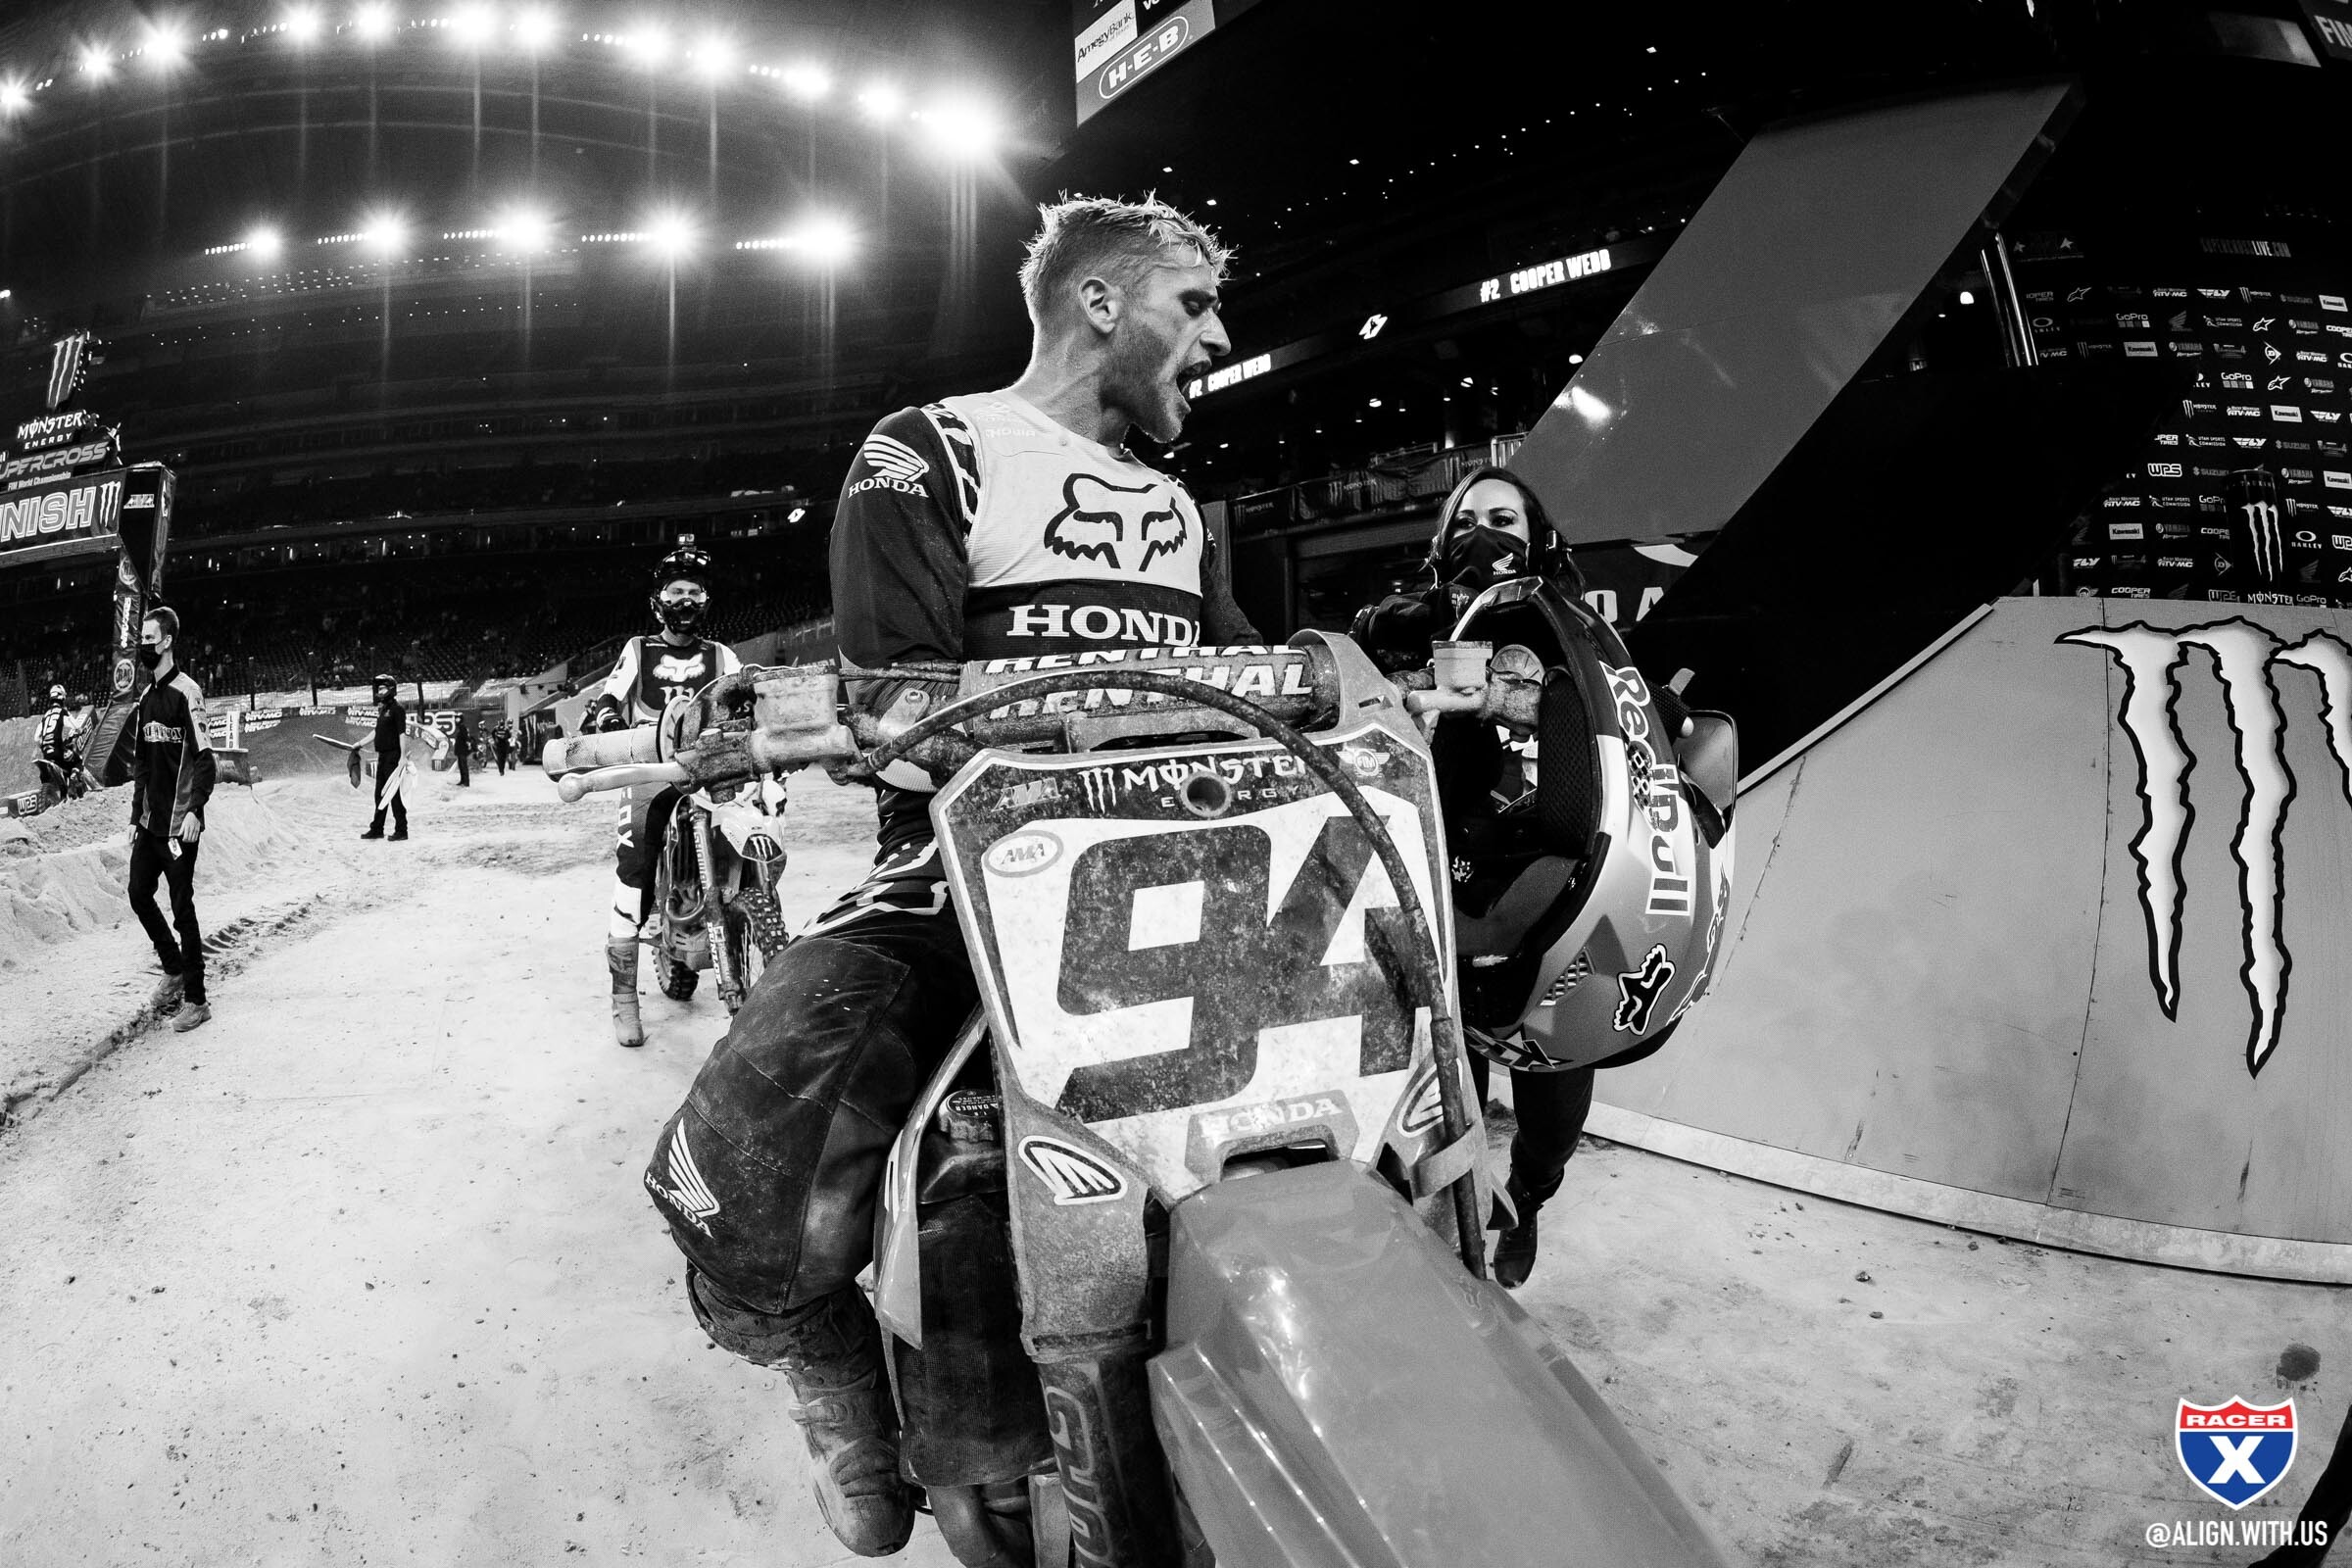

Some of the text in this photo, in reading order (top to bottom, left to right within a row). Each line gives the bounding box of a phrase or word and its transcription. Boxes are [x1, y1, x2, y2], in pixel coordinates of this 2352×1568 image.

[1479, 278, 1501, 303] #2
[1509, 261, 1566, 294] COOPER
[2221, 372, 2252, 381] GoPro
[24, 432, 73, 450] ENERGY
[2147, 463, 2183, 477] WPS
[847, 477, 930, 499] HONDA
[2072, 558, 2101, 567] FLY
[991, 777, 1060, 812] AMA
[706, 922, 723, 986] DUNLOP
[1054, 815, 1435, 1125] 94
[1197, 1099, 1344, 1135] HONDA
[645, 1171, 714, 1238] HONDA
